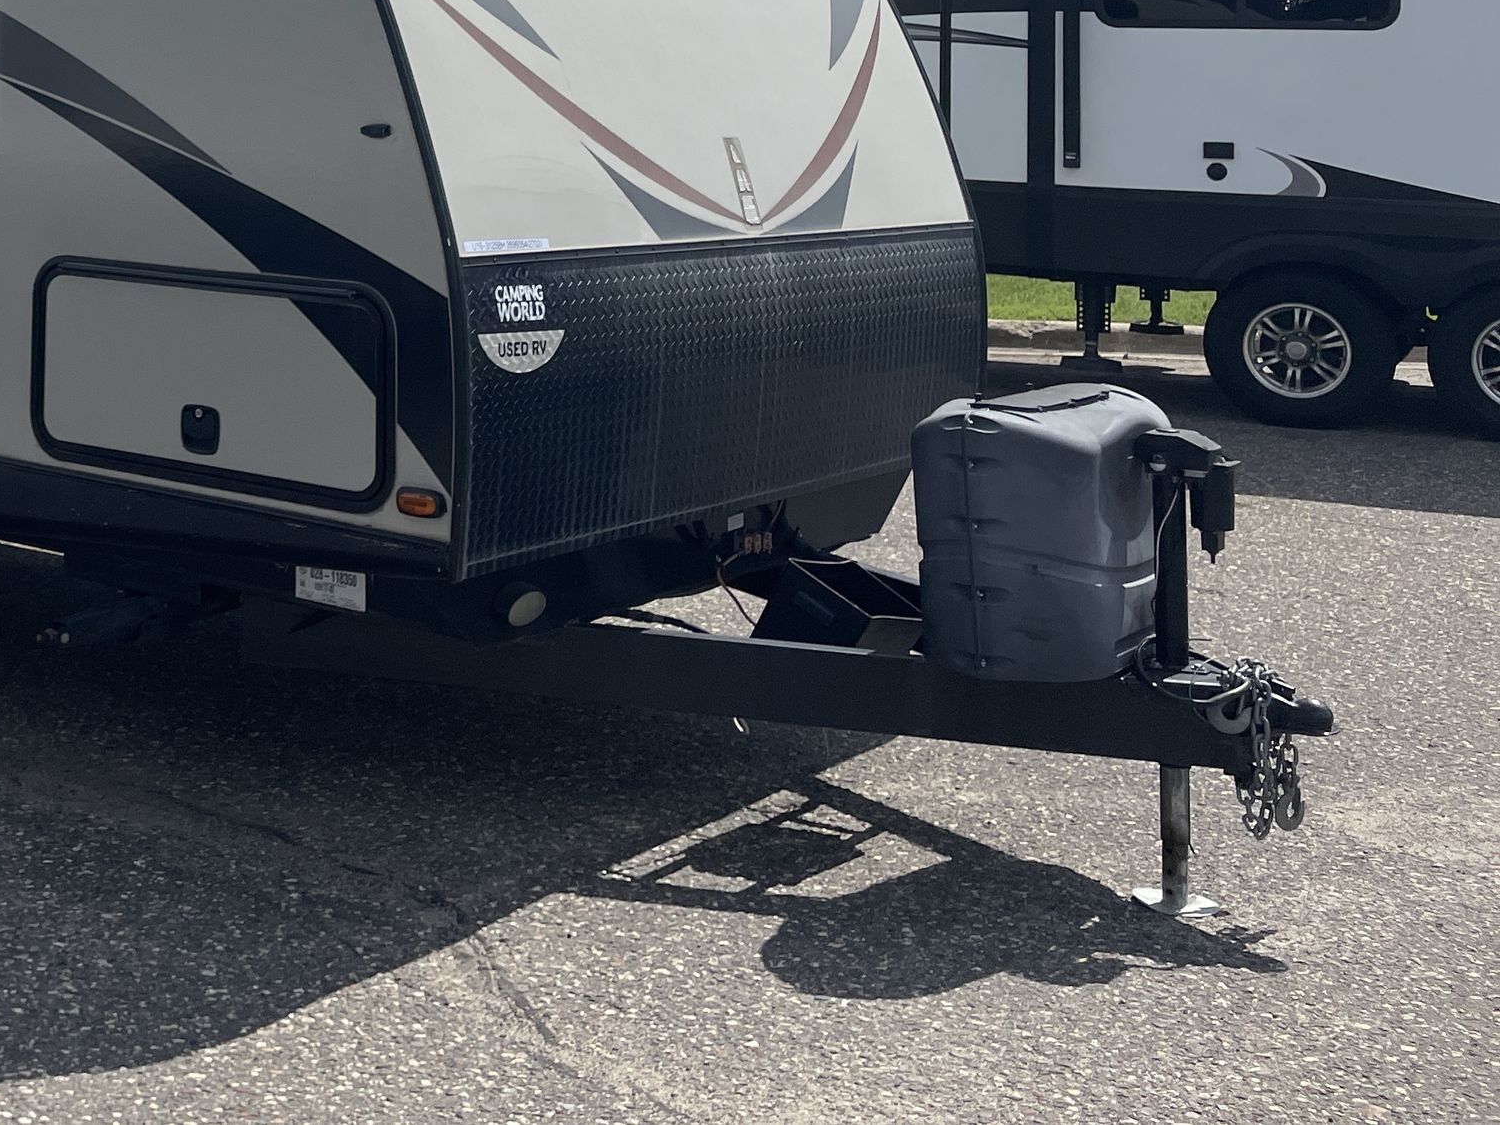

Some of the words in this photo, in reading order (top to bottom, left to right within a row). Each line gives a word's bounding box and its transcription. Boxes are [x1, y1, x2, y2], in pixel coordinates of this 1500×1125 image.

[495, 284, 544, 302] CAMPING
[496, 301, 546, 323] WORLD
[498, 341, 529, 357] USED
[532, 340, 547, 355] RV
